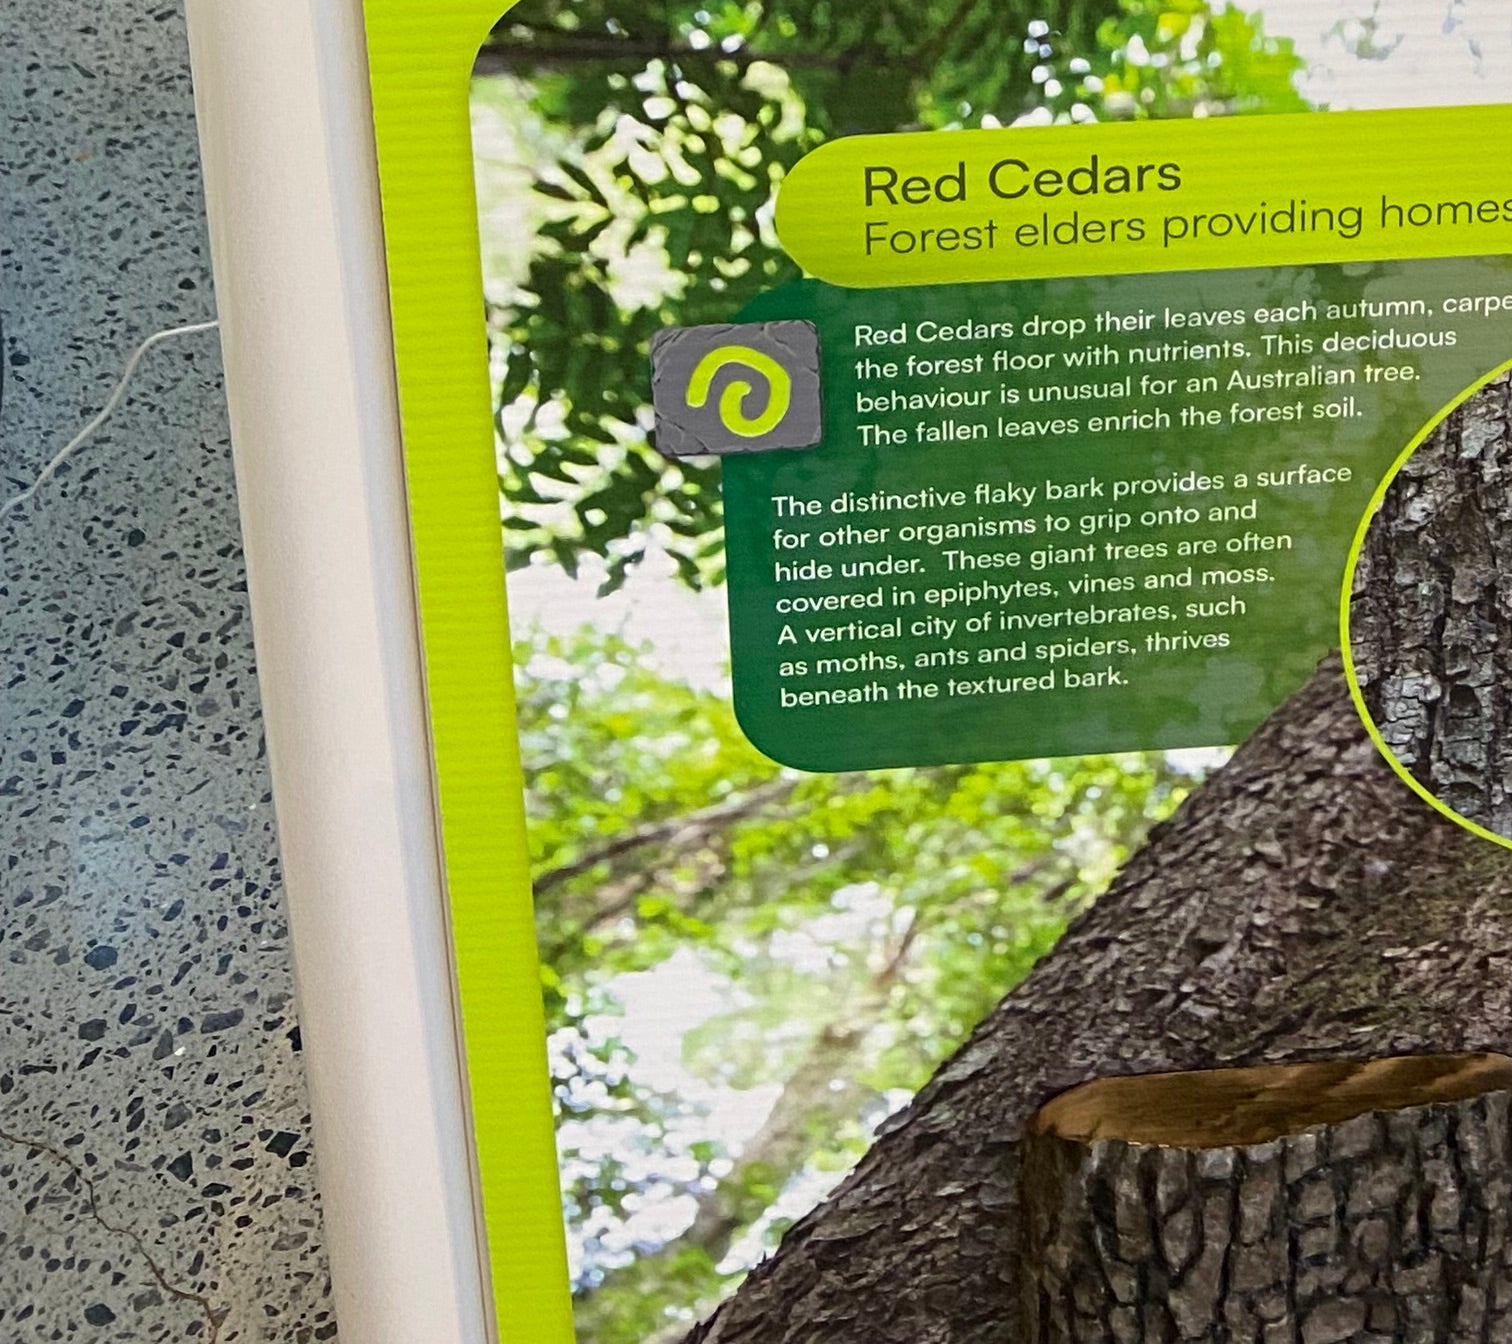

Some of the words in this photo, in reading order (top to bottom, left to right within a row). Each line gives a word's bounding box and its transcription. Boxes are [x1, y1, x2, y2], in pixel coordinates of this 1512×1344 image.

[864, 160, 967, 207] Red
[988, 153, 1182, 200] Cedars
[865, 219, 998, 256] Forest
[1015, 210, 1146, 247] elders
[1163, 199, 1363, 249] providing
[854, 322, 907, 349] Red
[915, 318, 1014, 343] Cedars
[1022, 314, 1087, 341] drop
[1094, 308, 1157, 333] their
[1164, 306, 1246, 329] leaves
[1253, 299, 1317, 324] each
[1326, 298, 1433, 320] autumn,
[854, 357, 899, 380] the
[905, 353, 984, 377] forest
[991, 349, 1056, 372] floor
[1062, 343, 1120, 368] with
[1128, 339, 1252, 365] nutrients.
[1260, 333, 1314, 356] This
[1322, 327, 1457, 353] deciduous
[856, 386, 992, 414] behaviour
[1000, 382, 1020, 405] is
[1028, 375, 1131, 403] unusual
[1139, 374, 1178, 396] for
[1185, 376, 1218, 394] an
[1226, 364, 1356, 391] Australian
[1363, 364, 1421, 384] tree.
[856, 423, 908, 447] The
[915, 419, 989, 443] fallen
[997, 416, 1080, 438] leaves
[1087, 407, 1171, 433] enrich
[1179, 405, 1222, 428] the
[1229, 400, 1304, 425] forest
[1312, 395, 1363, 419] soil.
[770, 495, 823, 518] The
[830, 486, 967, 514] distinctive
[973, 481, 1038, 508] flaky
[1045, 476, 1105, 501] bark
[1113, 470, 1225, 502] provides
[1233, 473, 1249, 489] a
[1256, 463, 1352, 487] surface
[772, 528, 811, 551] for
[818, 523, 891, 547] other
[898, 515, 1037, 546] organisms
[1043, 513, 1071, 533] to
[1079, 507, 1132, 536] grip
[1140, 505, 1201, 527] onto
[1208, 498, 1257, 522] and
[774, 558, 833, 583] hide
[841, 554, 926, 578] under.
[941, 549, 1022, 571] These
[1029, 543, 1097, 571] giant
[1104, 542, 1169, 561] trees
[1176, 539, 1218, 556] are
[1225, 531, 1292, 553] often
[775, 586, 884, 614] covered
[892, 585, 916, 607] in
[924, 579, 1059, 609] epiphytes,
[1067, 573, 1136, 595] vines
[1143, 566, 1193, 590] and
[1201, 567, 1276, 586] moss.
[777, 624, 798, 646] A
[804, 616, 902, 644] vertical
[910, 614, 958, 641] city
[965, 610, 993, 633] of
[999, 603, 1178, 631] invertebrates,
[1185, 594, 1246, 618] such
[778, 660, 809, 677] as
[816, 650, 906, 675] moths,
[914, 647, 970, 668] ants
[977, 640, 1027, 664] and
[1035, 636, 1137, 665] spiders,
[1144, 629, 1231, 653] thrives
[780, 680, 889, 708] beneath
[895, 679, 939, 700] the
[946, 668, 1055, 697] textured
[1064, 665, 1129, 689] bark.
